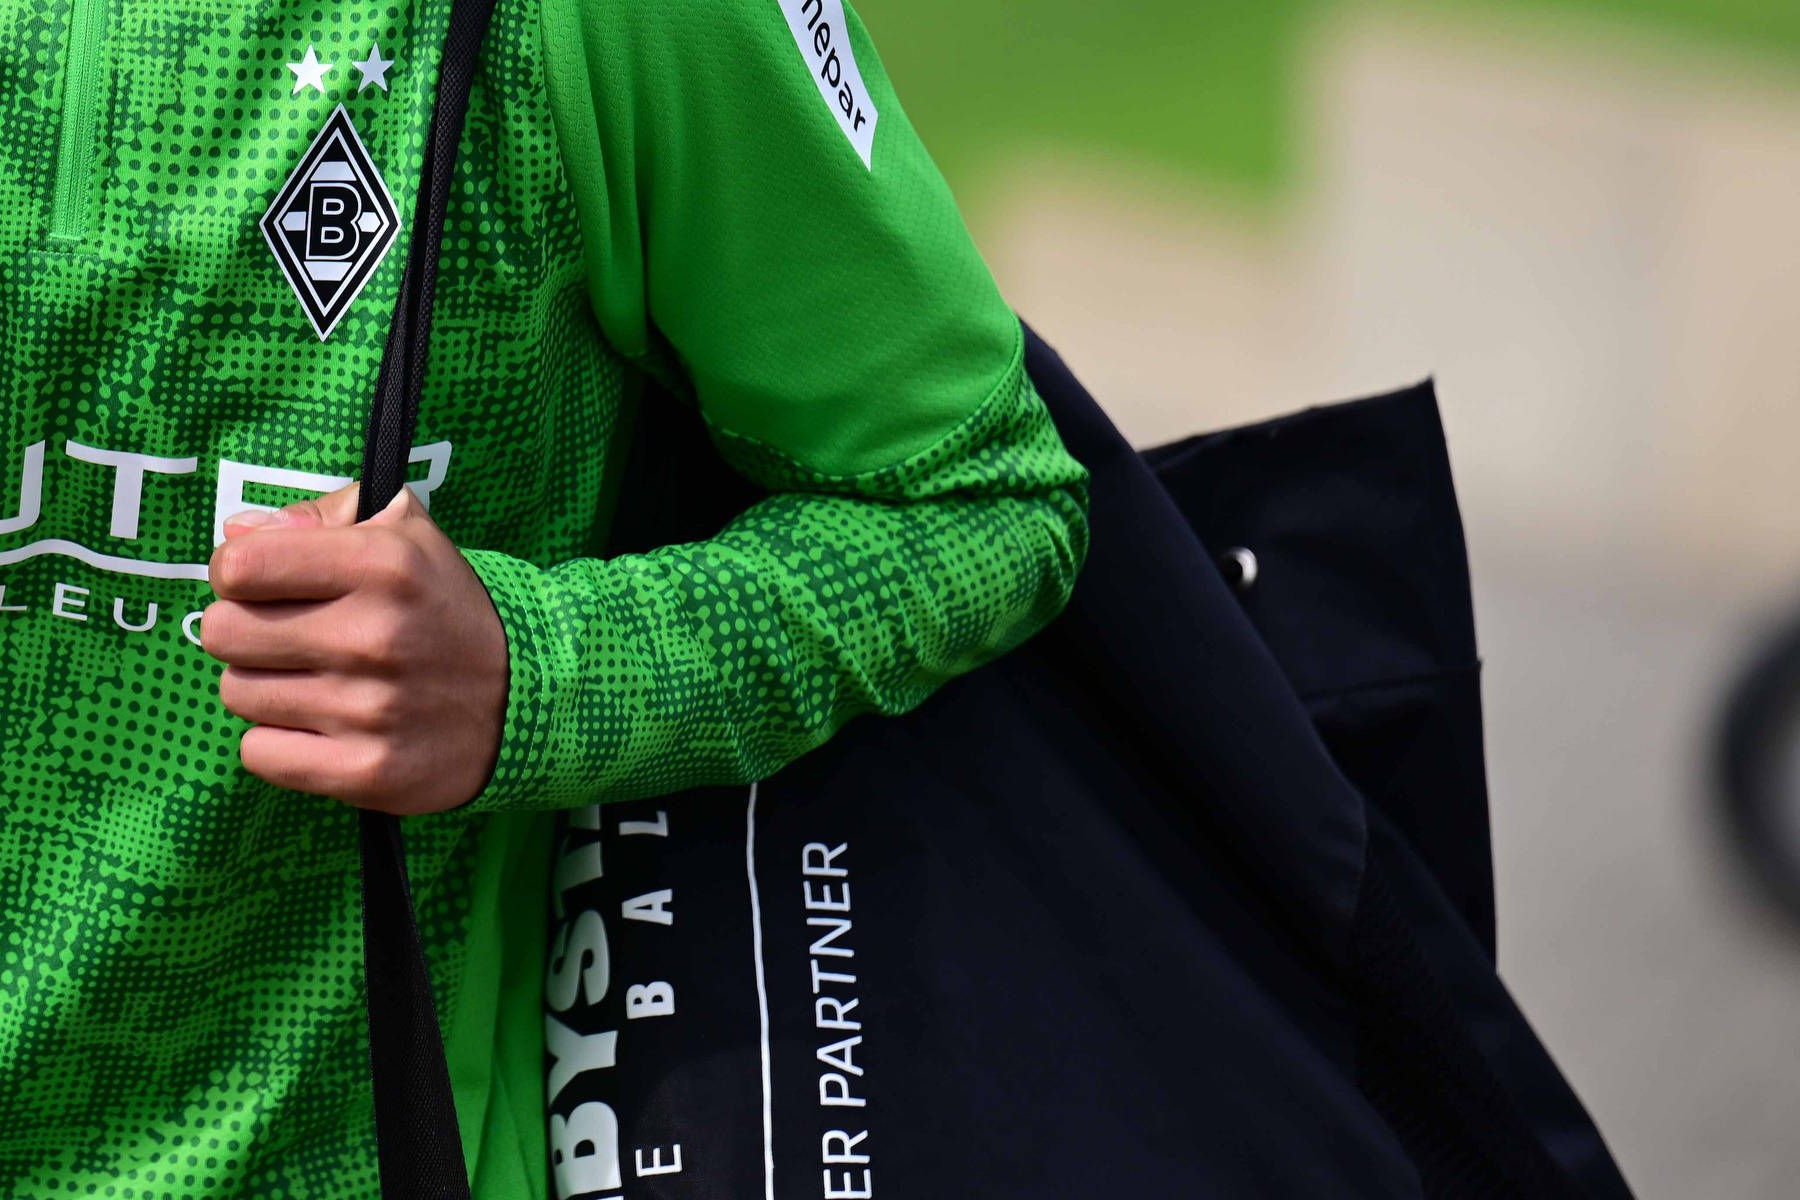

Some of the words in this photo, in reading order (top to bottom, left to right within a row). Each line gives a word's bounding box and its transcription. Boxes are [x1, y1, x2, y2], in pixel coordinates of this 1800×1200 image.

[305, 182, 362, 260] B
[546, 804, 624, 1200] BYST
[802, 842, 867, 1107] PARTNER
